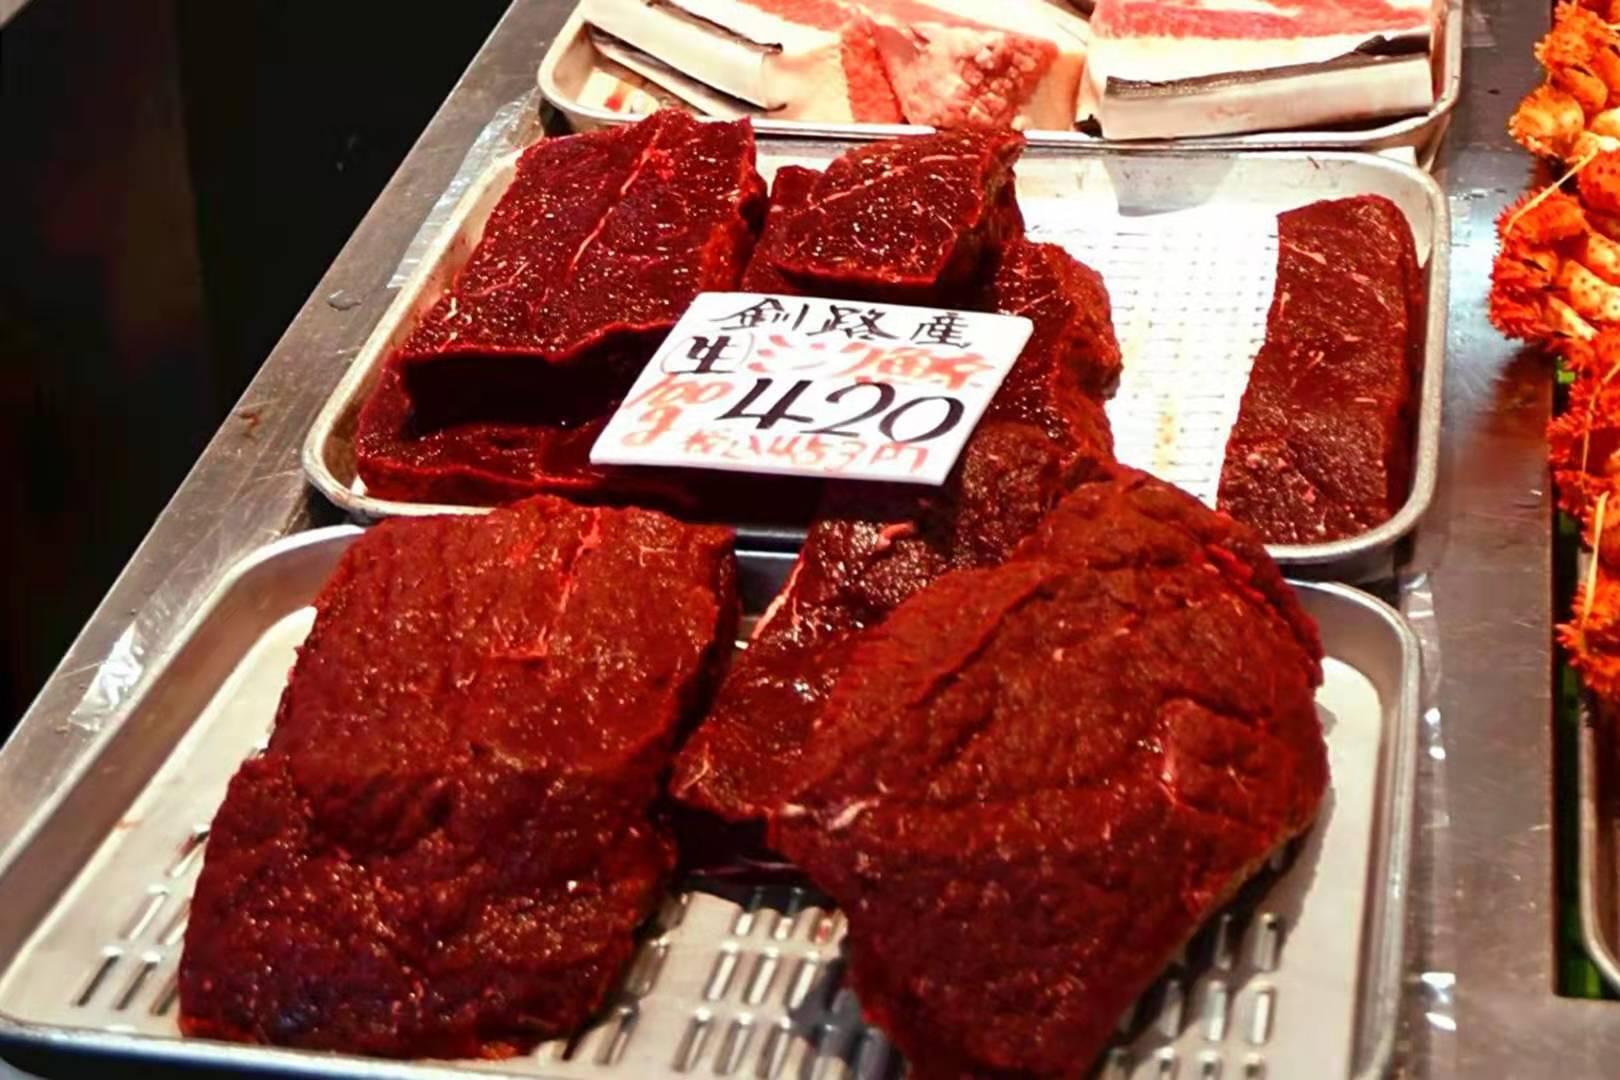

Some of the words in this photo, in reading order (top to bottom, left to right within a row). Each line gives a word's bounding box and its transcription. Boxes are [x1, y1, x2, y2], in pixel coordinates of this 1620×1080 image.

[710, 297, 971, 349] 釧路産
[715, 377, 965, 443] 420
